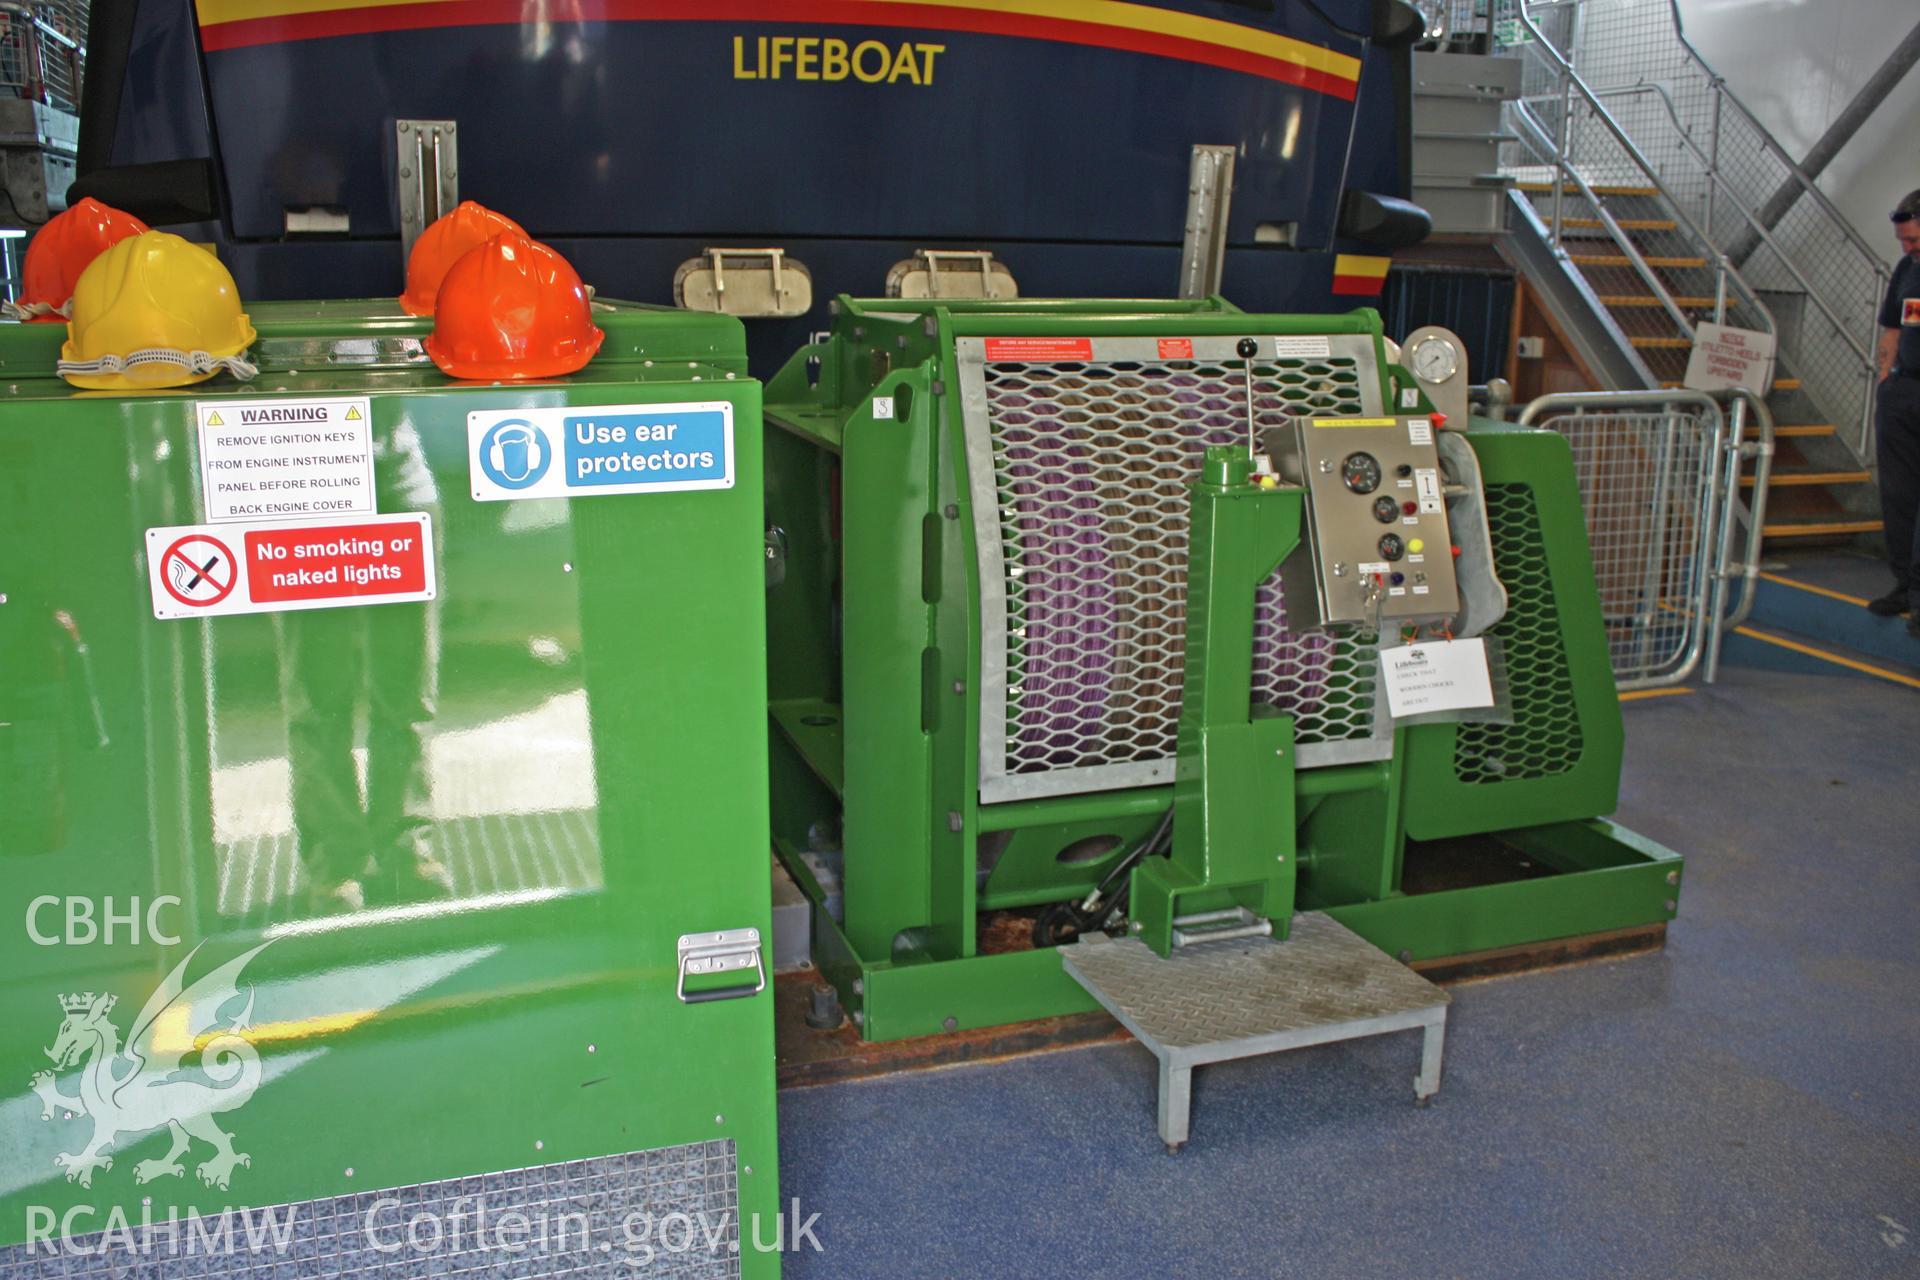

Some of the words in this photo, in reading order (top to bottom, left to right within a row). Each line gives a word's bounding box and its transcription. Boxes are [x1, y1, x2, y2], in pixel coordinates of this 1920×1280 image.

[734, 36, 945, 85] LIFEBOAT
[241, 407, 328, 422] WARNING
[217, 435, 267, 446] REMOVE
[271, 434, 321, 444] IGNITION
[324, 432, 355, 442] KEYS
[575, 422, 627, 444] Use
[635, 423, 678, 441] ear
[208, 460, 242, 470] FROM
[246, 457, 289, 469] ENGINE
[293, 454, 367, 466] INSTRUMENT
[577, 449, 714, 478] protectors
[218, 481, 256, 492] PANEL
[259, 479, 307, 491] BEFORE
[310, 477, 361, 488] ROLLING
[230, 504, 263, 515] BACK
[266, 501, 310, 513] ENGINE
[313, 500, 353, 511] COVER
[257, 542, 287, 560] No
[294, 539, 384, 560] smoking
[390, 537, 413, 552] or
[272, 566, 337, 587] naked
[343, 564, 402, 586] lights
